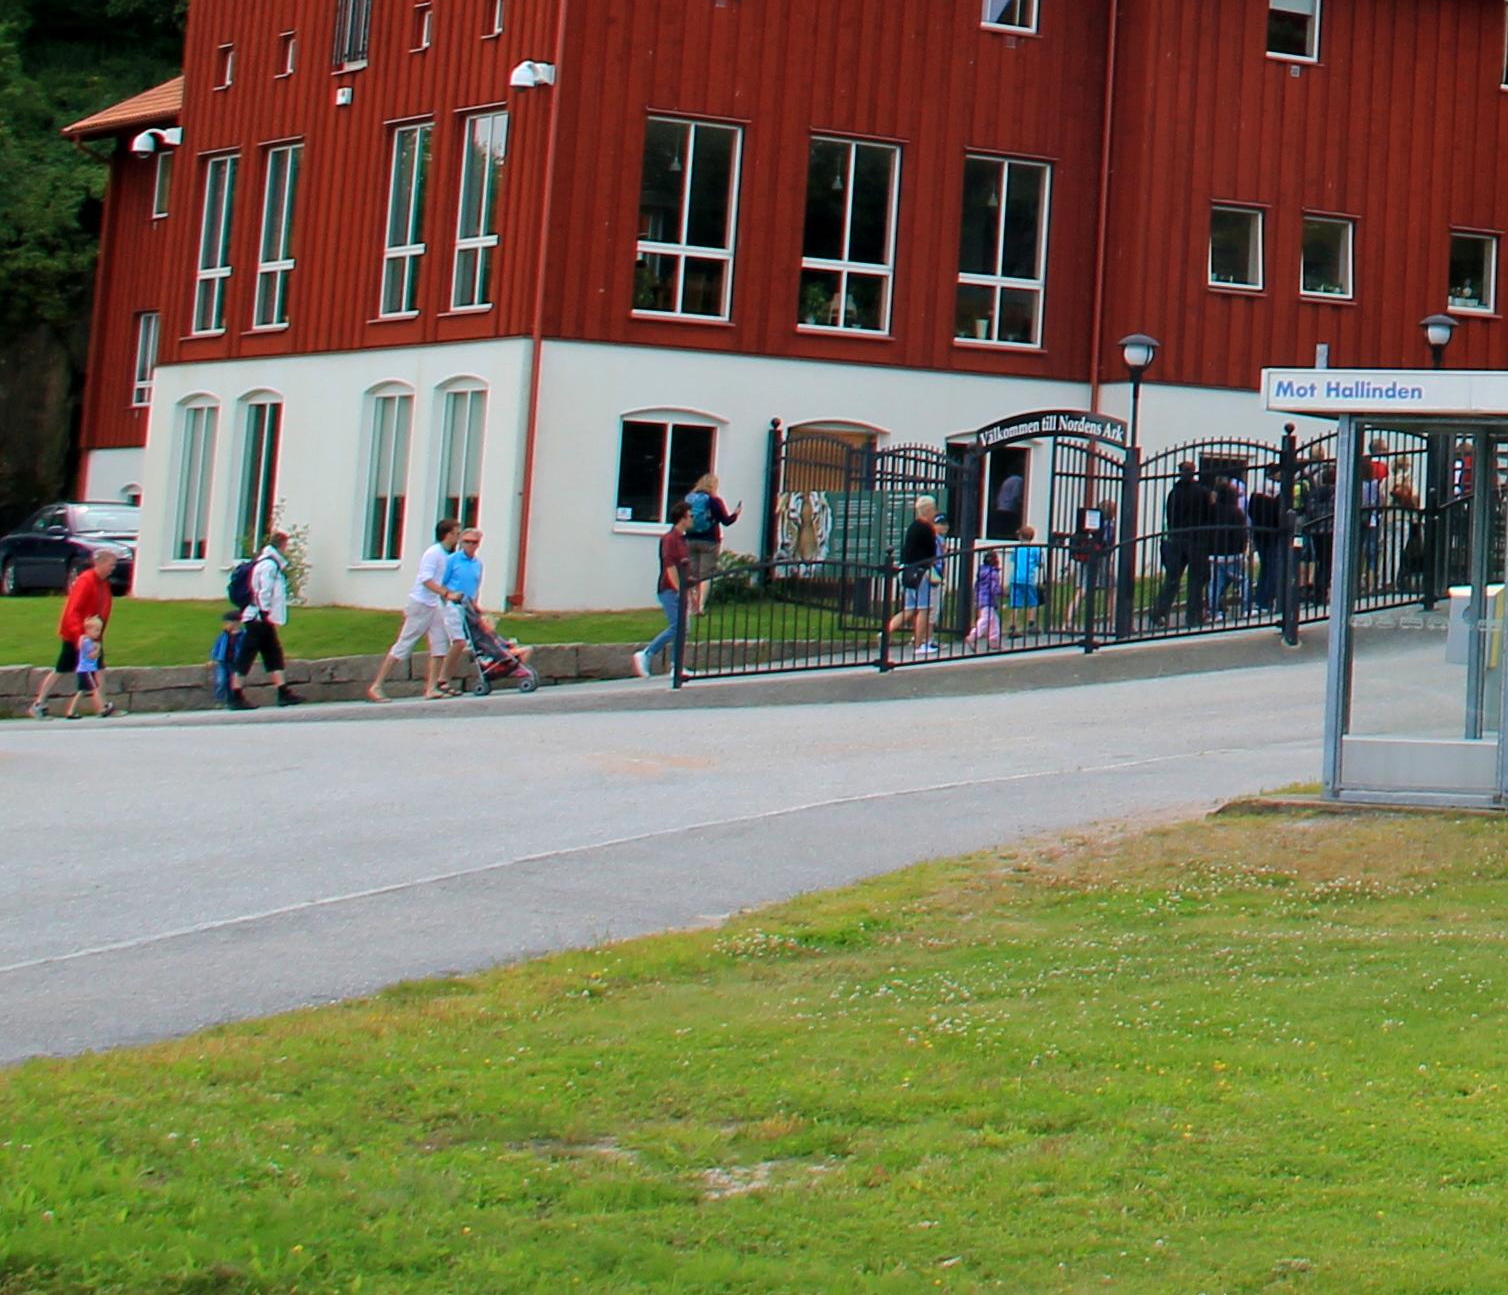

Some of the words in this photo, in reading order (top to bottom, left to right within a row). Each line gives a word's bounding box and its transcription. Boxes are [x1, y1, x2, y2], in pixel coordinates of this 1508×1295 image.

[1275, 380, 1317, 398] Mot
[1326, 380, 1423, 399] Hallinden
[979, 421, 1040, 446] Välkommen
[1041, 415, 1057, 431] till
[1058, 415, 1102, 435] Nordens
[1103, 423, 1125, 442] Ark
